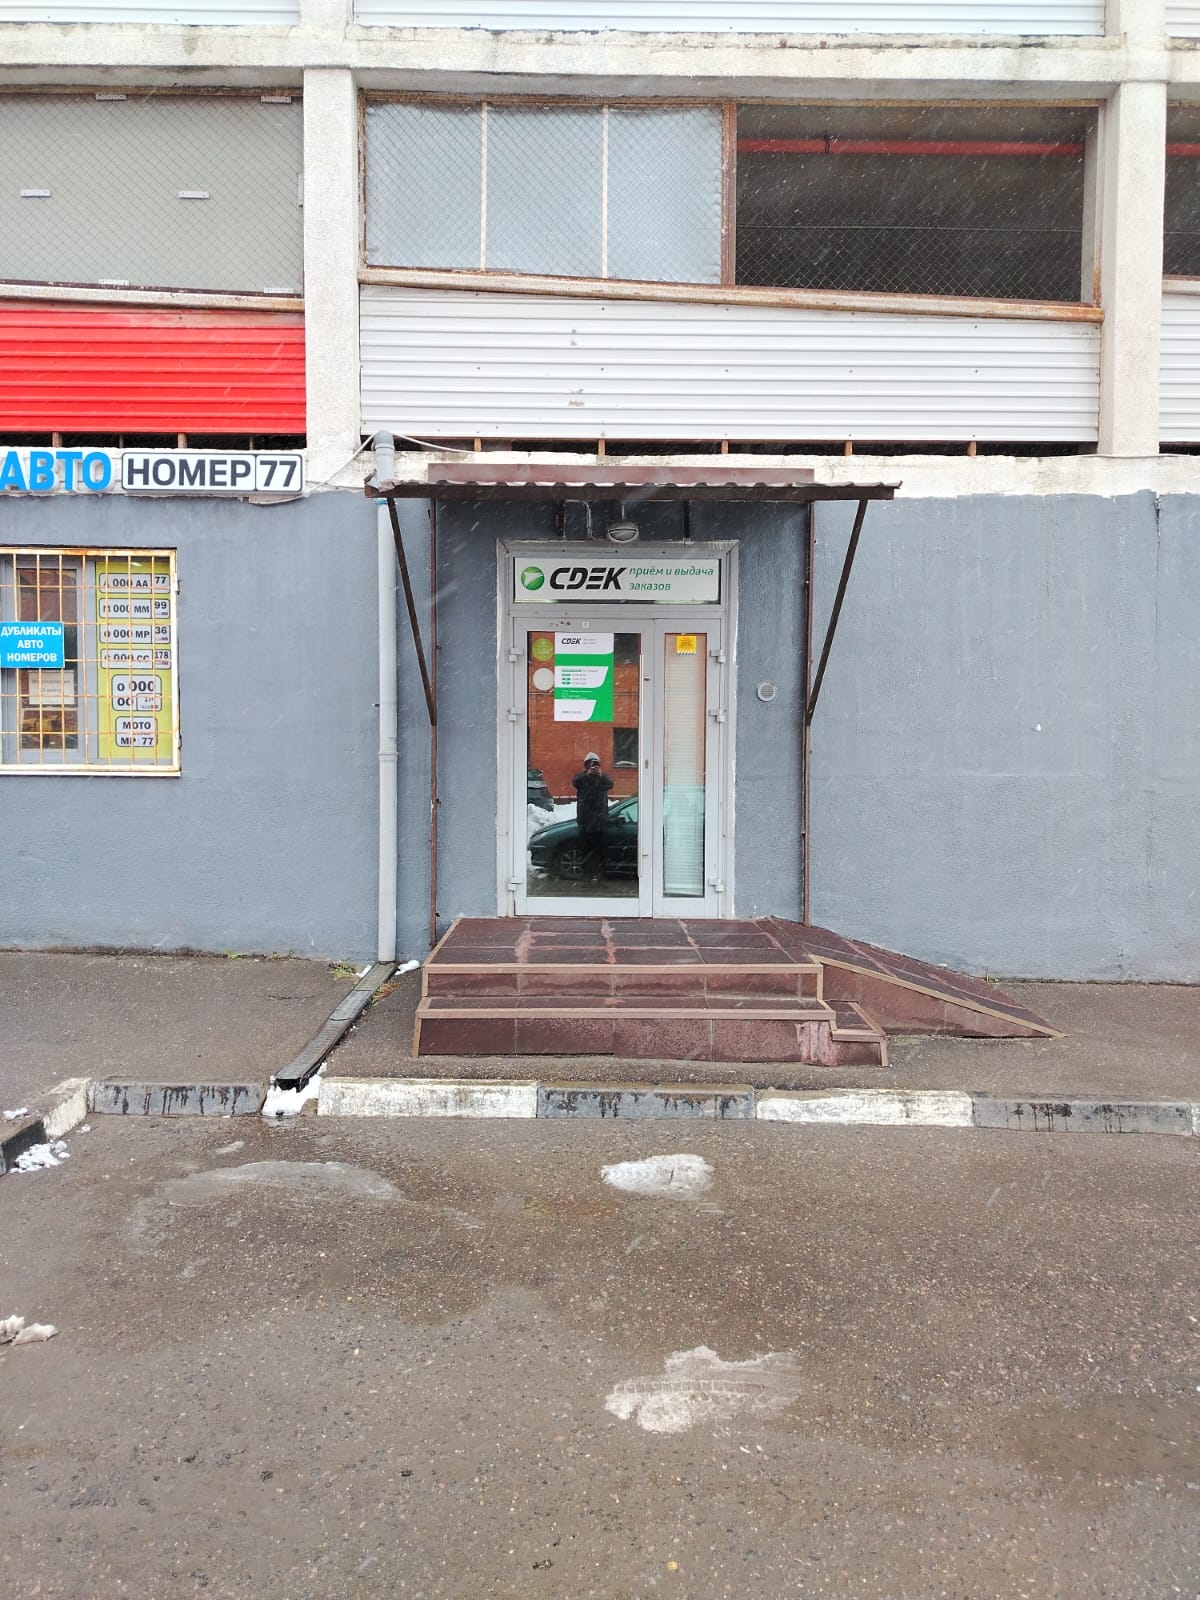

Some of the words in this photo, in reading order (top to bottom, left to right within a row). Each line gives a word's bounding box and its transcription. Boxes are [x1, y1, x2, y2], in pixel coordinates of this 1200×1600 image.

[0, 451, 111, 491] АВТО
[127, 458, 251, 487] НОМЕР
[259, 460, 298, 487] 77
[629, 565, 664, 577] приём
[666, 568, 672, 576] и
[674, 567, 714, 577] выдача
[154, 576, 167, 584] 77
[550, 567, 628, 590] CDEK
[629, 582, 671, 591] заказов
[154, 601, 167, 610] 99
[1, 626, 61, 637] ДУБЛИКАТЫ
[155, 626, 167, 635] 36
[17, 640, 43, 649] АВТО
[7, 652, 57, 662] НОМЕРОВ
[155, 651, 169, 659] 178
[122, 721, 151, 729] МОТО
[141, 737, 153, 745] 77
